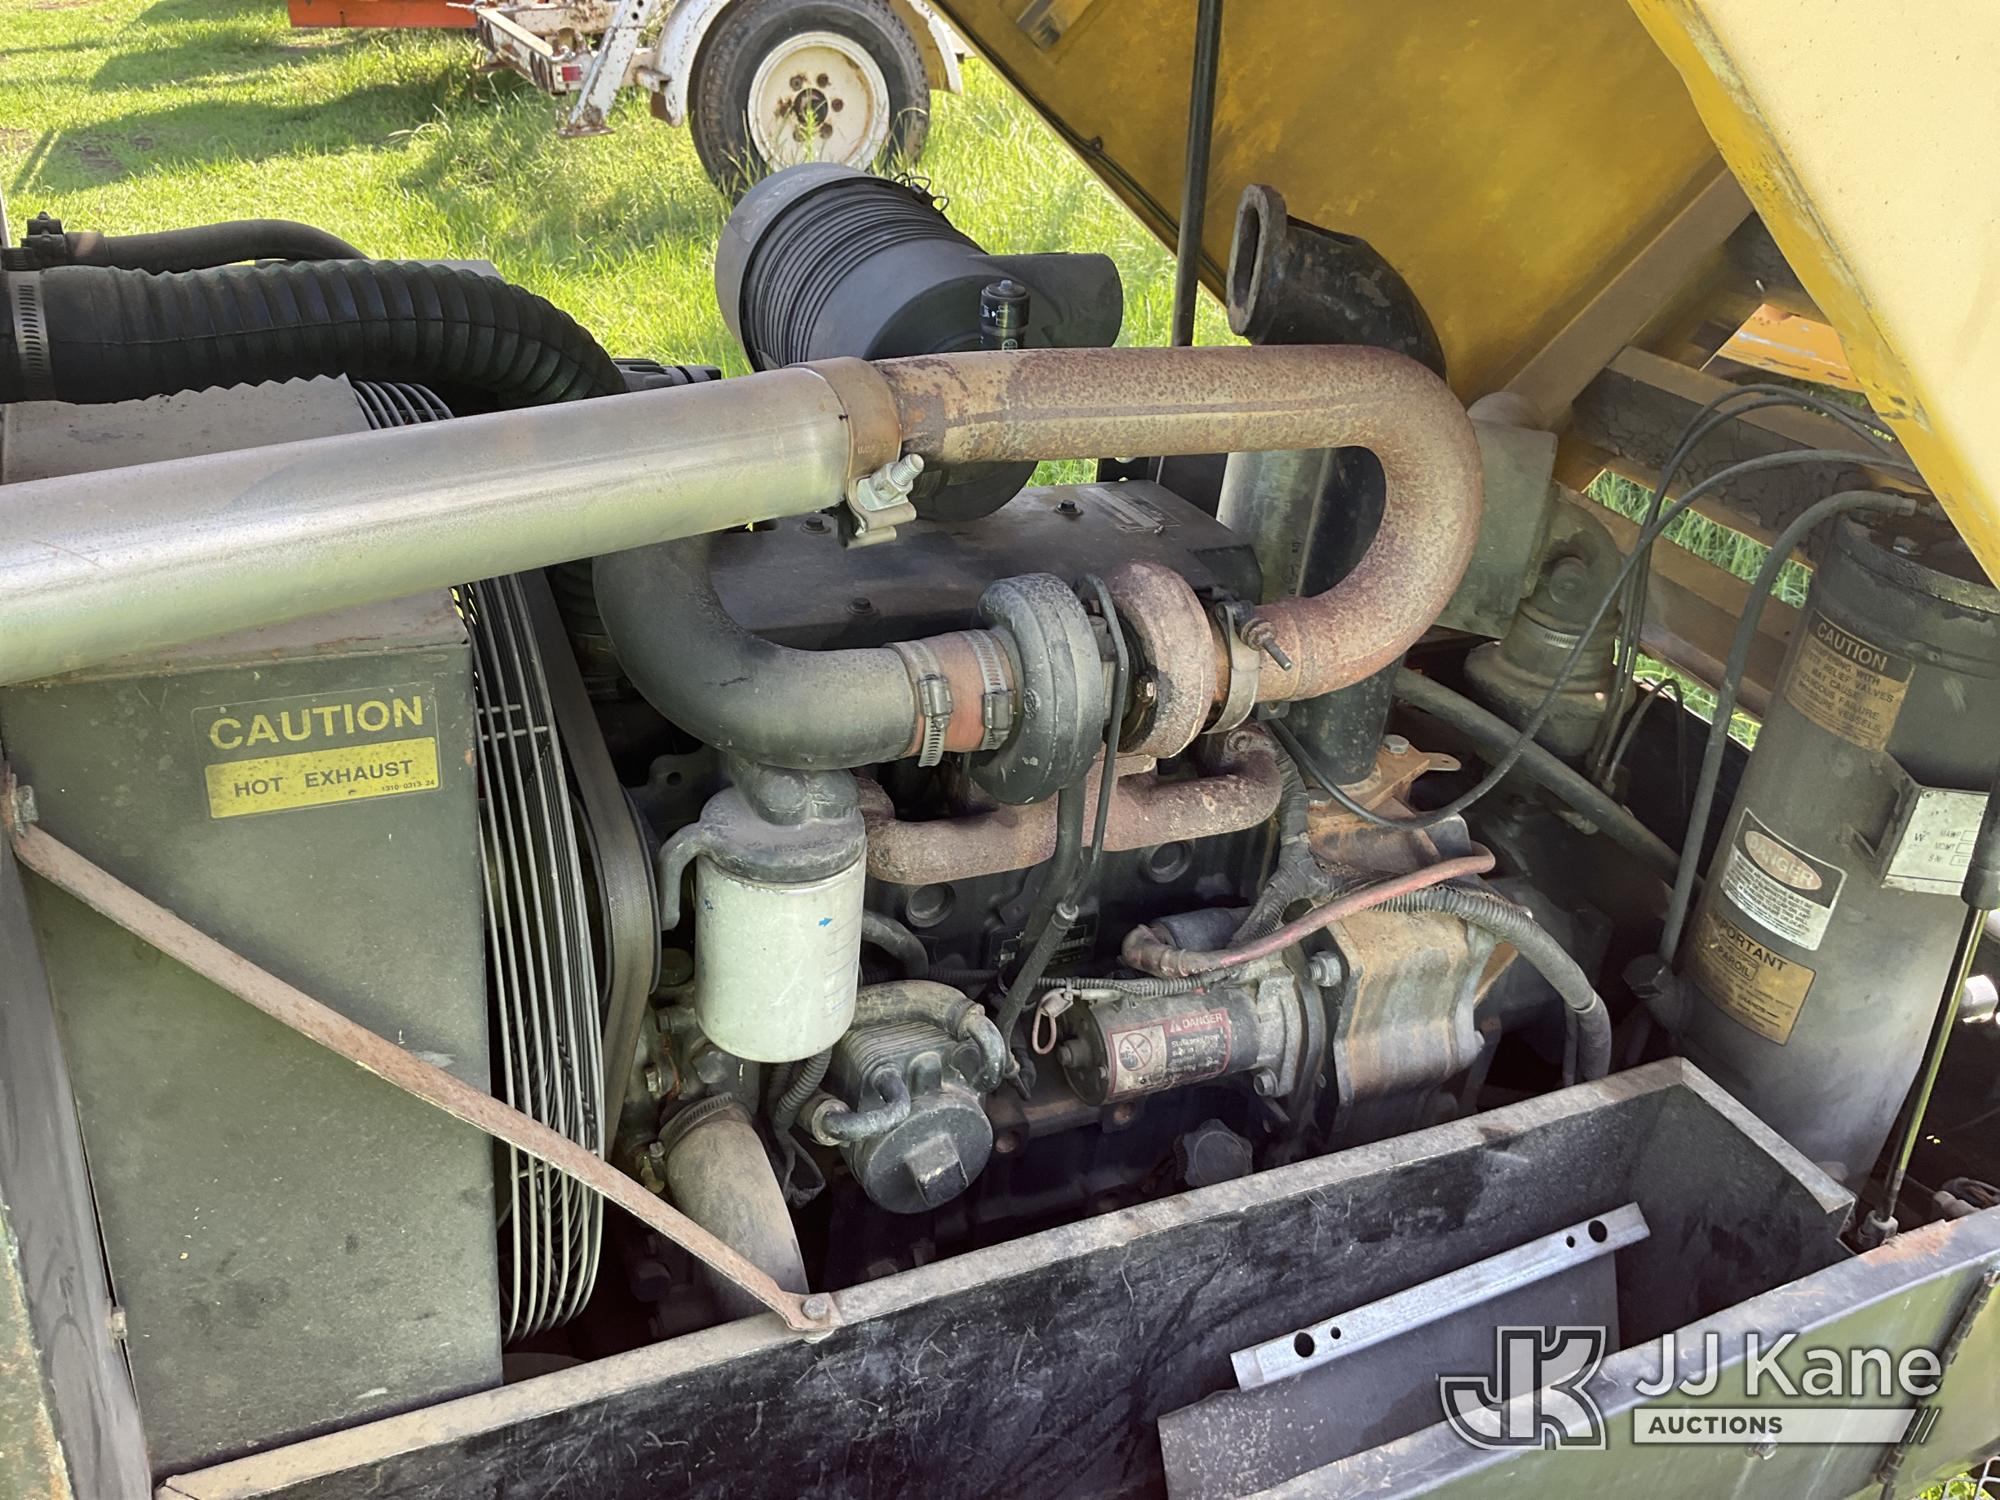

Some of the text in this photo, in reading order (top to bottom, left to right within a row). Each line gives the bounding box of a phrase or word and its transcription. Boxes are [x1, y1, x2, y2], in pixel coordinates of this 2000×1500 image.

[1816, 622, 1888, 672] CAUTION
[208, 696, 424, 750] CAUTION
[234, 760, 413, 798] HOT EXHAUST
[1748, 836, 1814, 887] DANGER
[1716, 944, 1751, 978] PAROIL
[1182, 1013, 1223, 1028] DANGER
